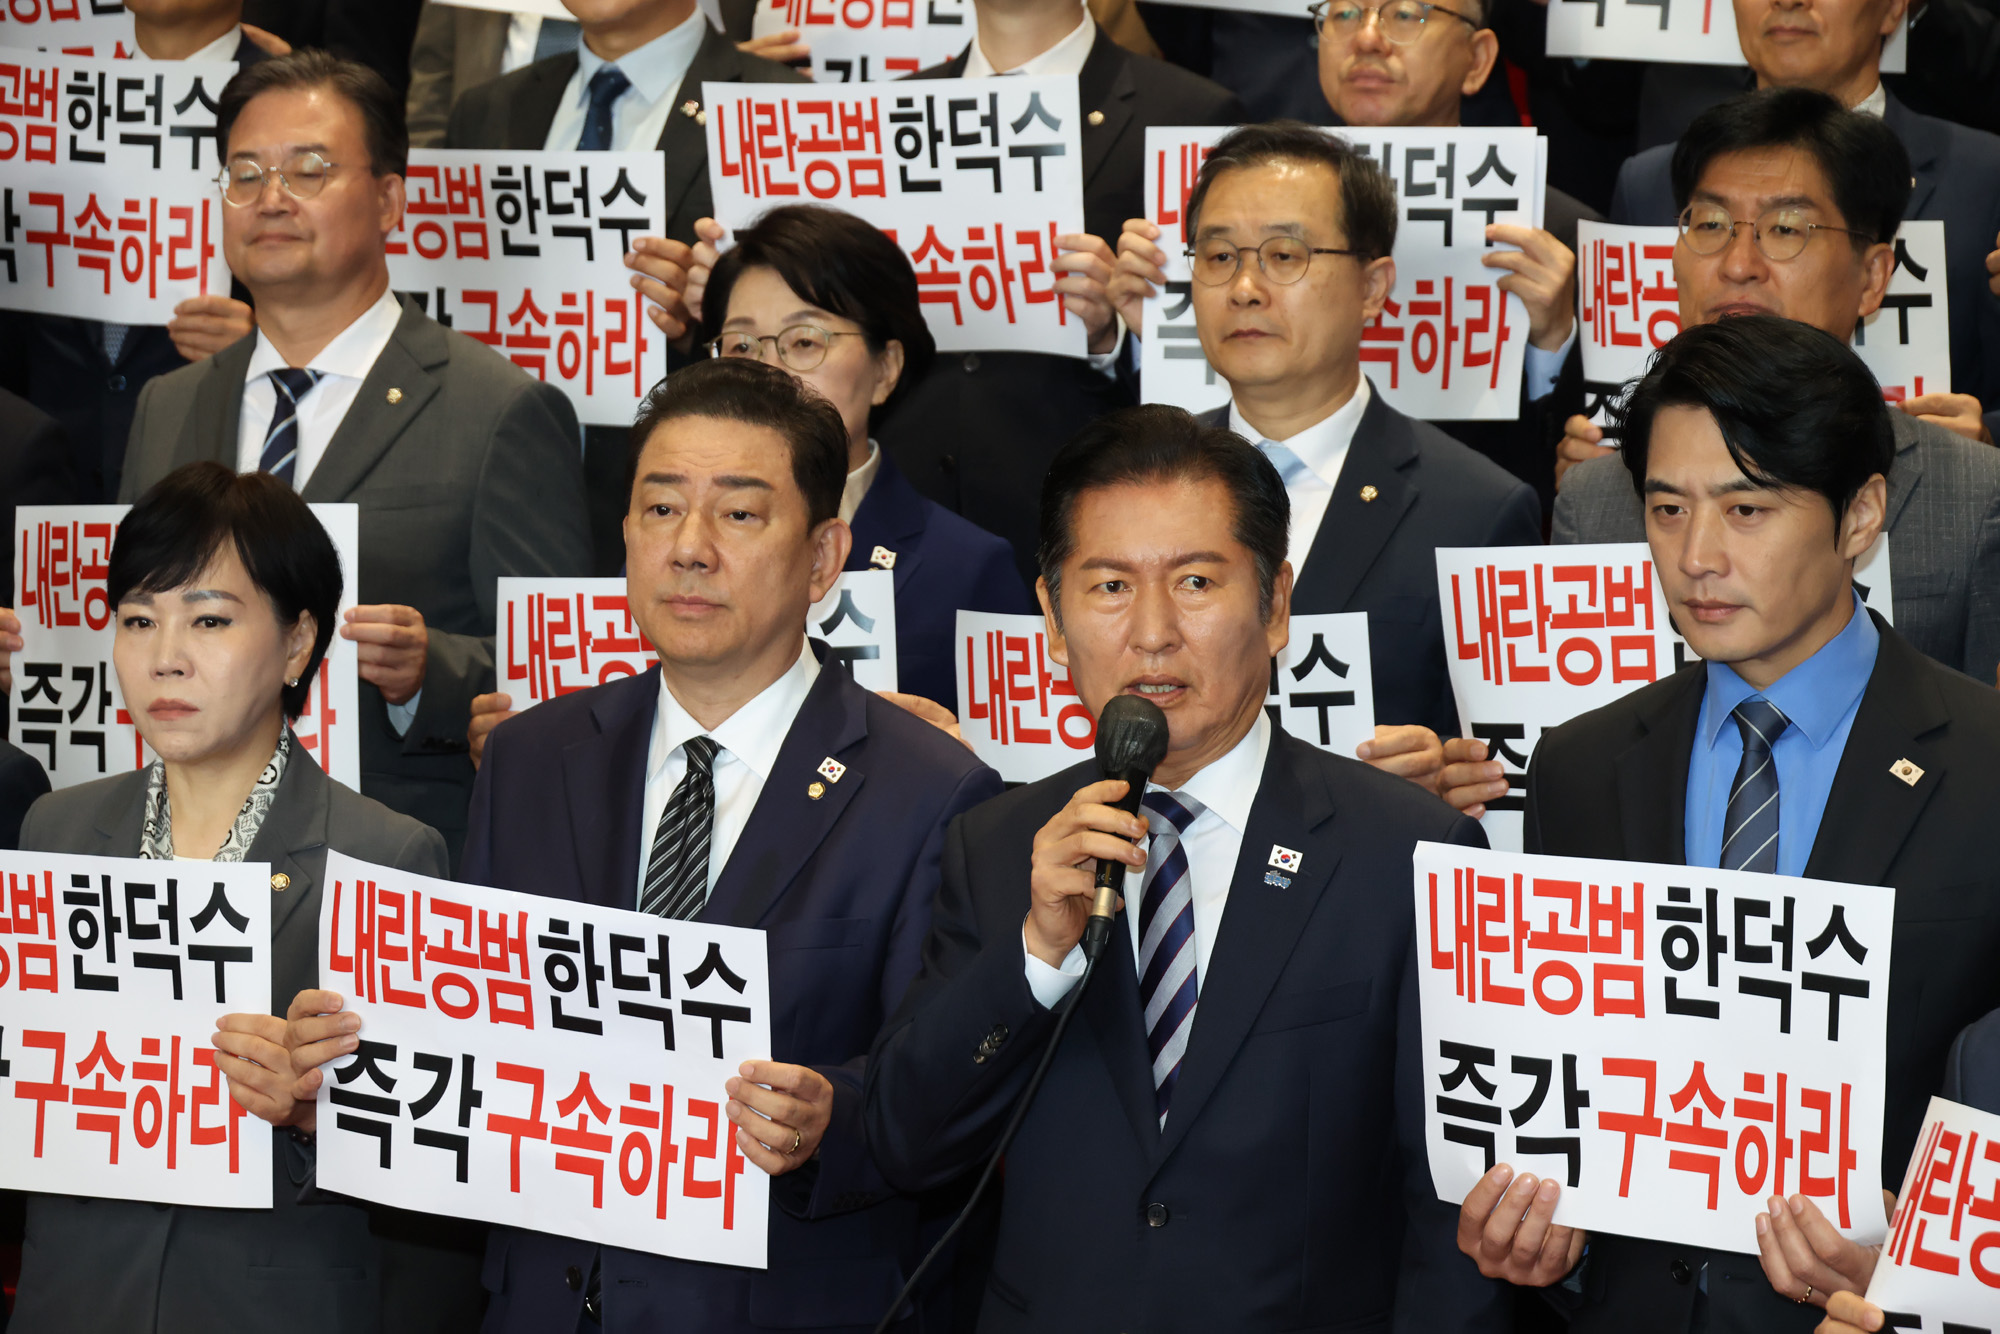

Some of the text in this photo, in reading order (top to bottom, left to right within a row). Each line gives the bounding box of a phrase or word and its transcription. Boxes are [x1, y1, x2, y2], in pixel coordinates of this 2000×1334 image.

[0, 62, 220, 170] 공범 한덕수
[717, 97, 886, 199] 내란공범
[889, 91, 1066, 194] 한덕수
[26, 192, 215, 299] 구속하라
[385, 164, 650, 261] 공범 한덕수
[880, 221, 1069, 326] 속하라
[1583, 239, 1684, 349] 내란공
[1359, 276, 1510, 390] 속하라
[21, 520, 120, 631] 내란공
[1451, 560, 1658, 686] 내란공범
[507, 592, 661, 702] 내란공
[18, 661, 112, 773] 즉각
[63, 874, 253, 1003] 한덕수
[329, 879, 752, 1060] 내란공범 한덕수
[1428, 867, 1870, 1042] 내란공범 한덕수
[15, 1029, 247, 1174] 구속하라
[329, 1039, 745, 1231] 즉각 구속하라
[1436, 1039, 1857, 1229] 즉각 구속하라
